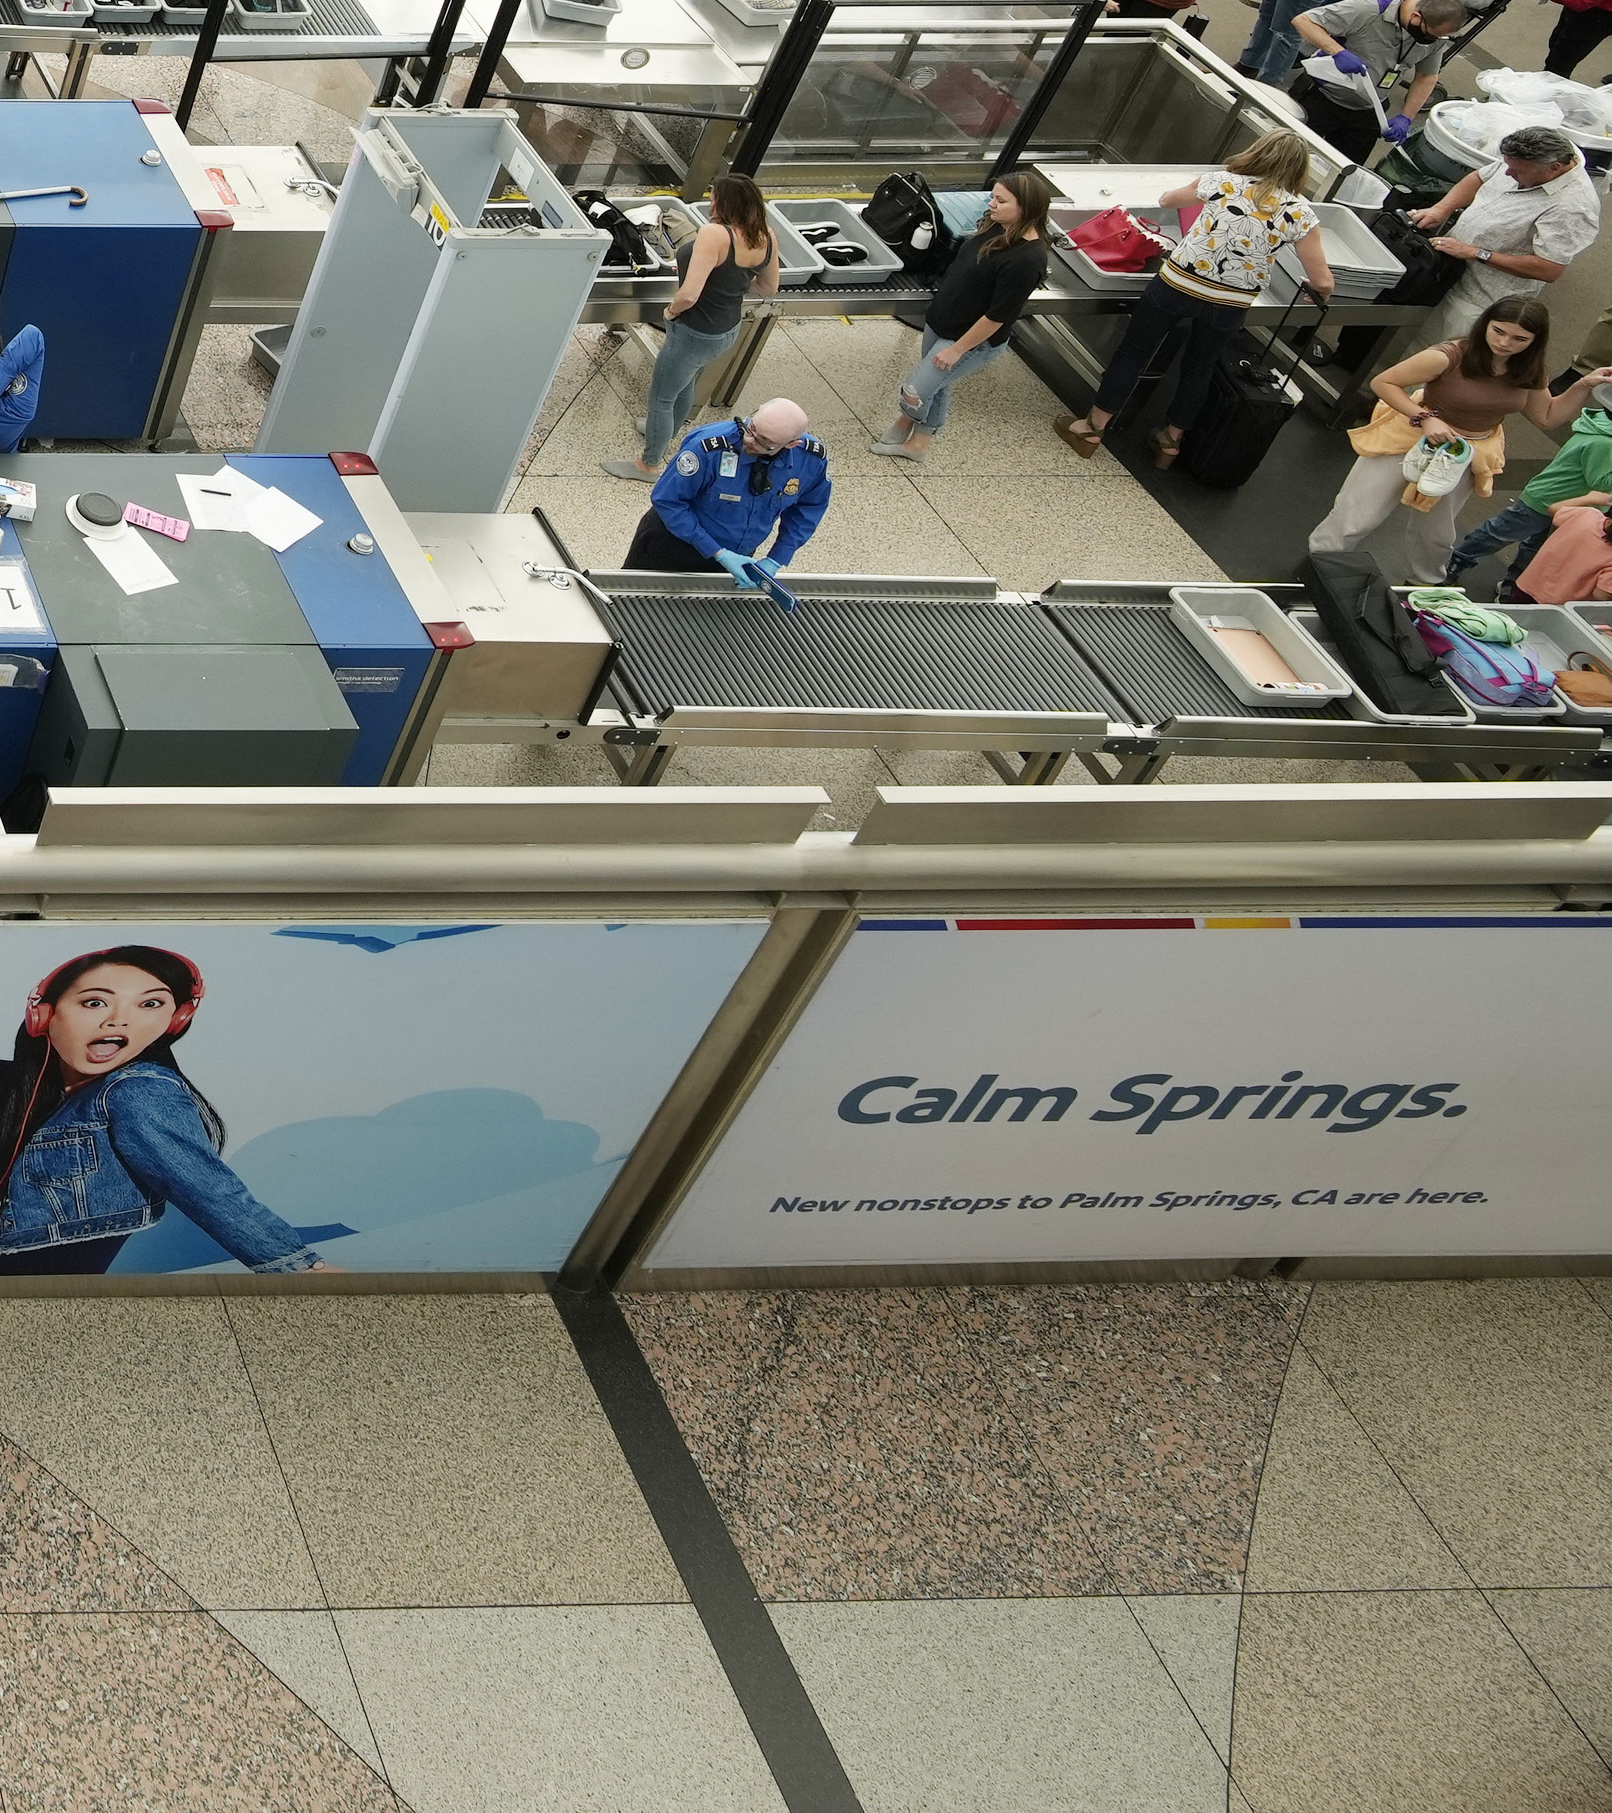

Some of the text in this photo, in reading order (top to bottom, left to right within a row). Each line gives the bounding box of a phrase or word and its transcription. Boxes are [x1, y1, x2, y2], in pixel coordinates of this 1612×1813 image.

[837, 1070, 1470, 1136] Calm Springs.
[769, 1187, 1490, 1215] New nonstops to Palm Springs, CA are here.
